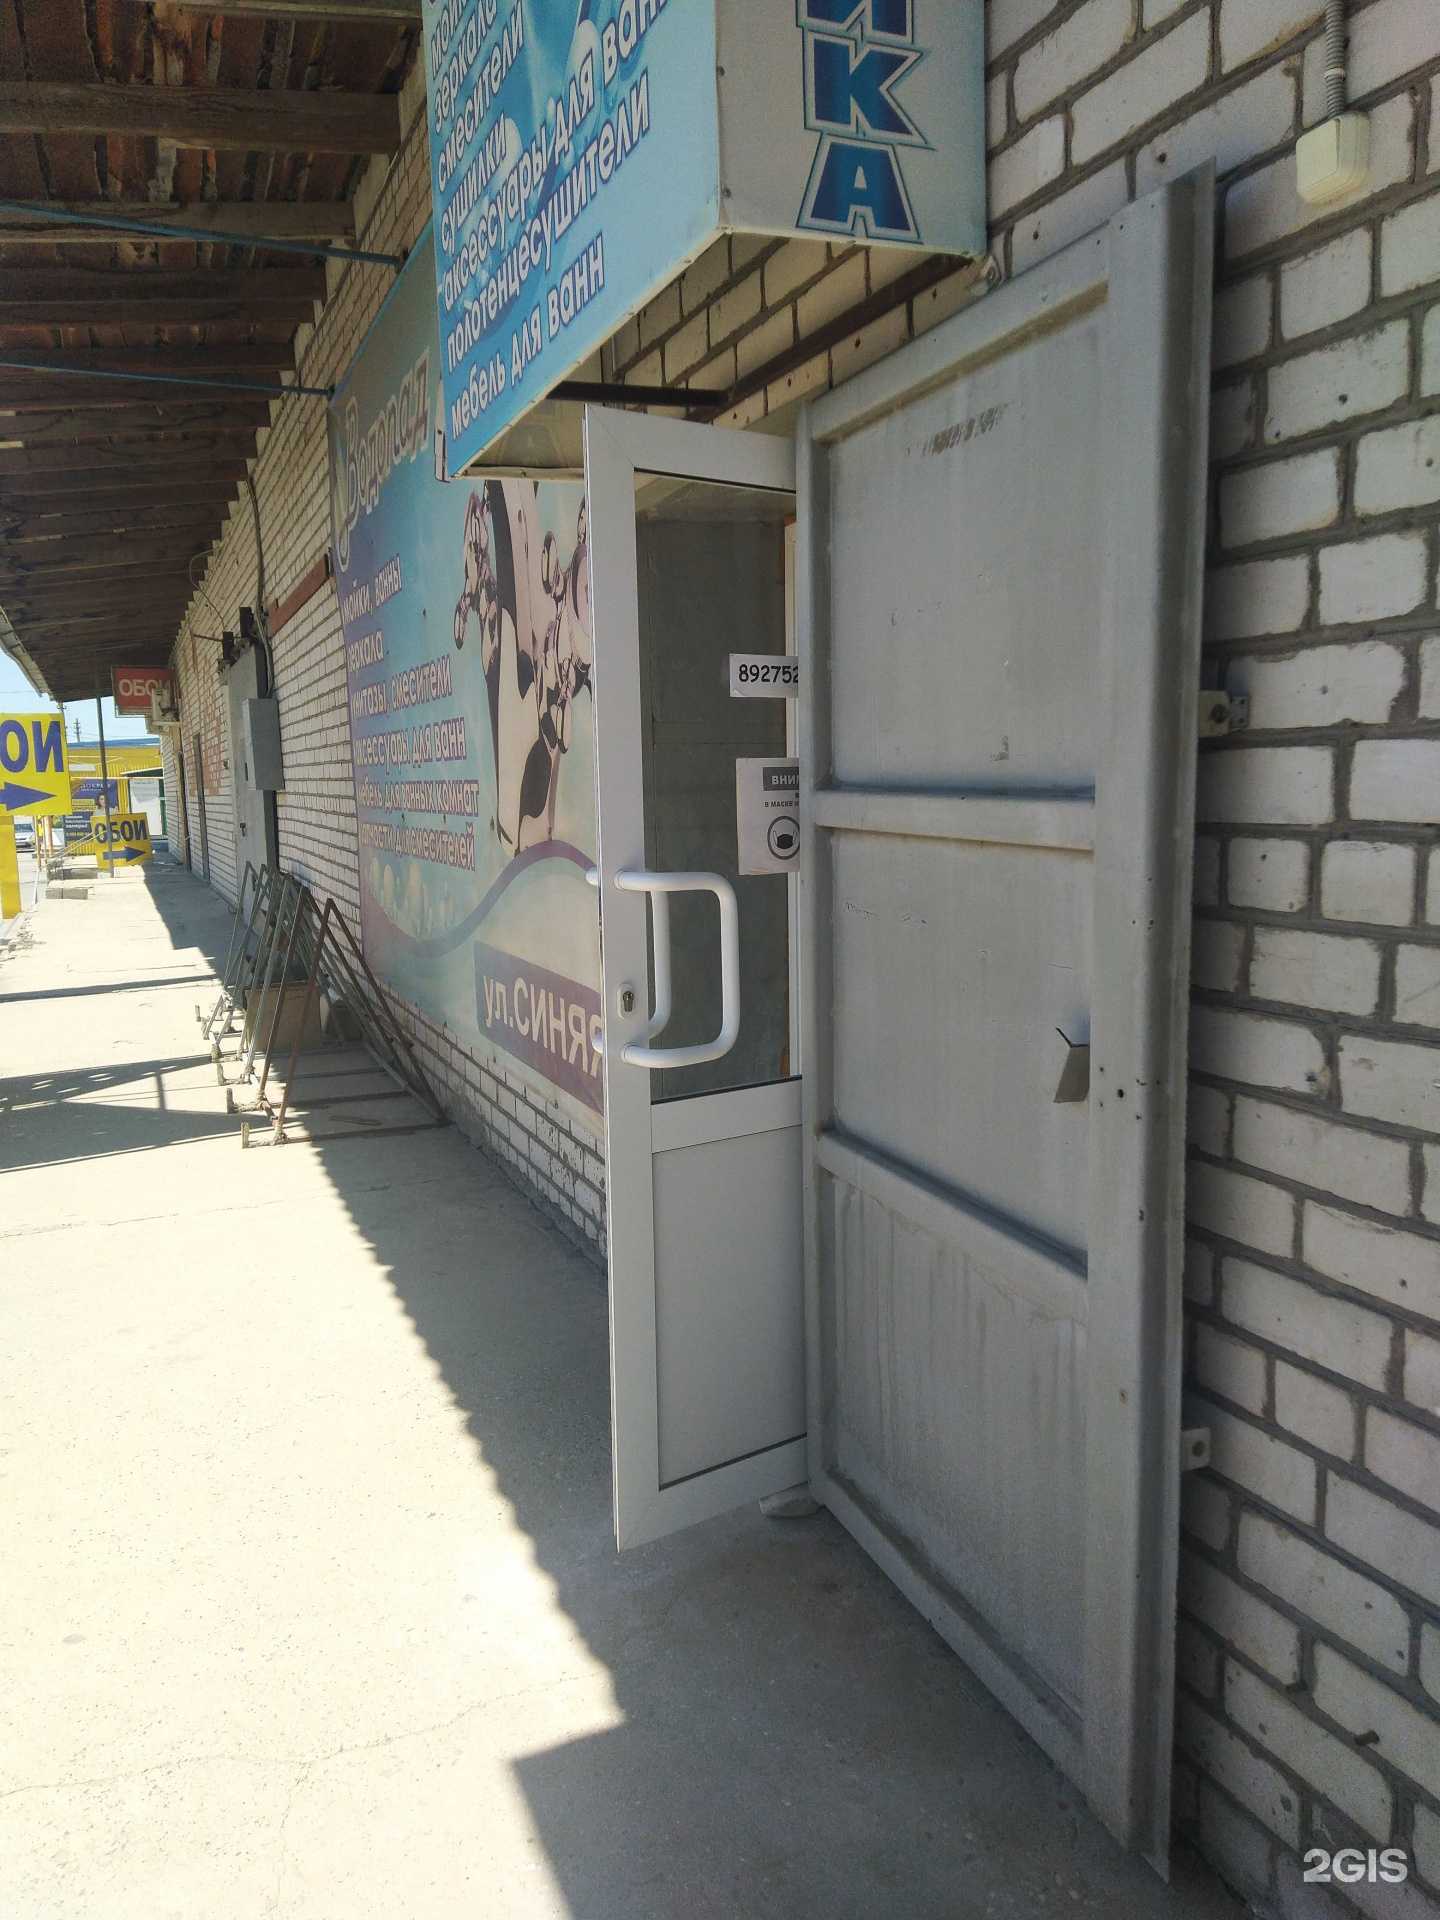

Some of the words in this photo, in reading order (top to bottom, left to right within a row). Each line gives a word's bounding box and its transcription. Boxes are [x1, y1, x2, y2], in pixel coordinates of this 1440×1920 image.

[438, 0, 524, 193] смесители
[441, 113, 507, 254] сушилки
[444, 123, 549, 310] аксессуары
[553, 47, 595, 165] для
[447, 68, 650, 373] полотенцесушители
[451, 352, 506, 440] мебель
[511, 304, 542, 388] для
[548, 232, 605, 342] ванн
[338, 347, 430, 571] Водопад
[375, 554, 402, 606] ванны
[391, 654, 453, 710] смесители
[412, 726, 433, 767] для
[434, 716, 467, 761] ванн
[771, 775, 799, 785] ВНИ
[95, 820, 148, 844] ОБОИ
[384, 781, 401, 814] для
[435, 779, 480, 817] комнат
